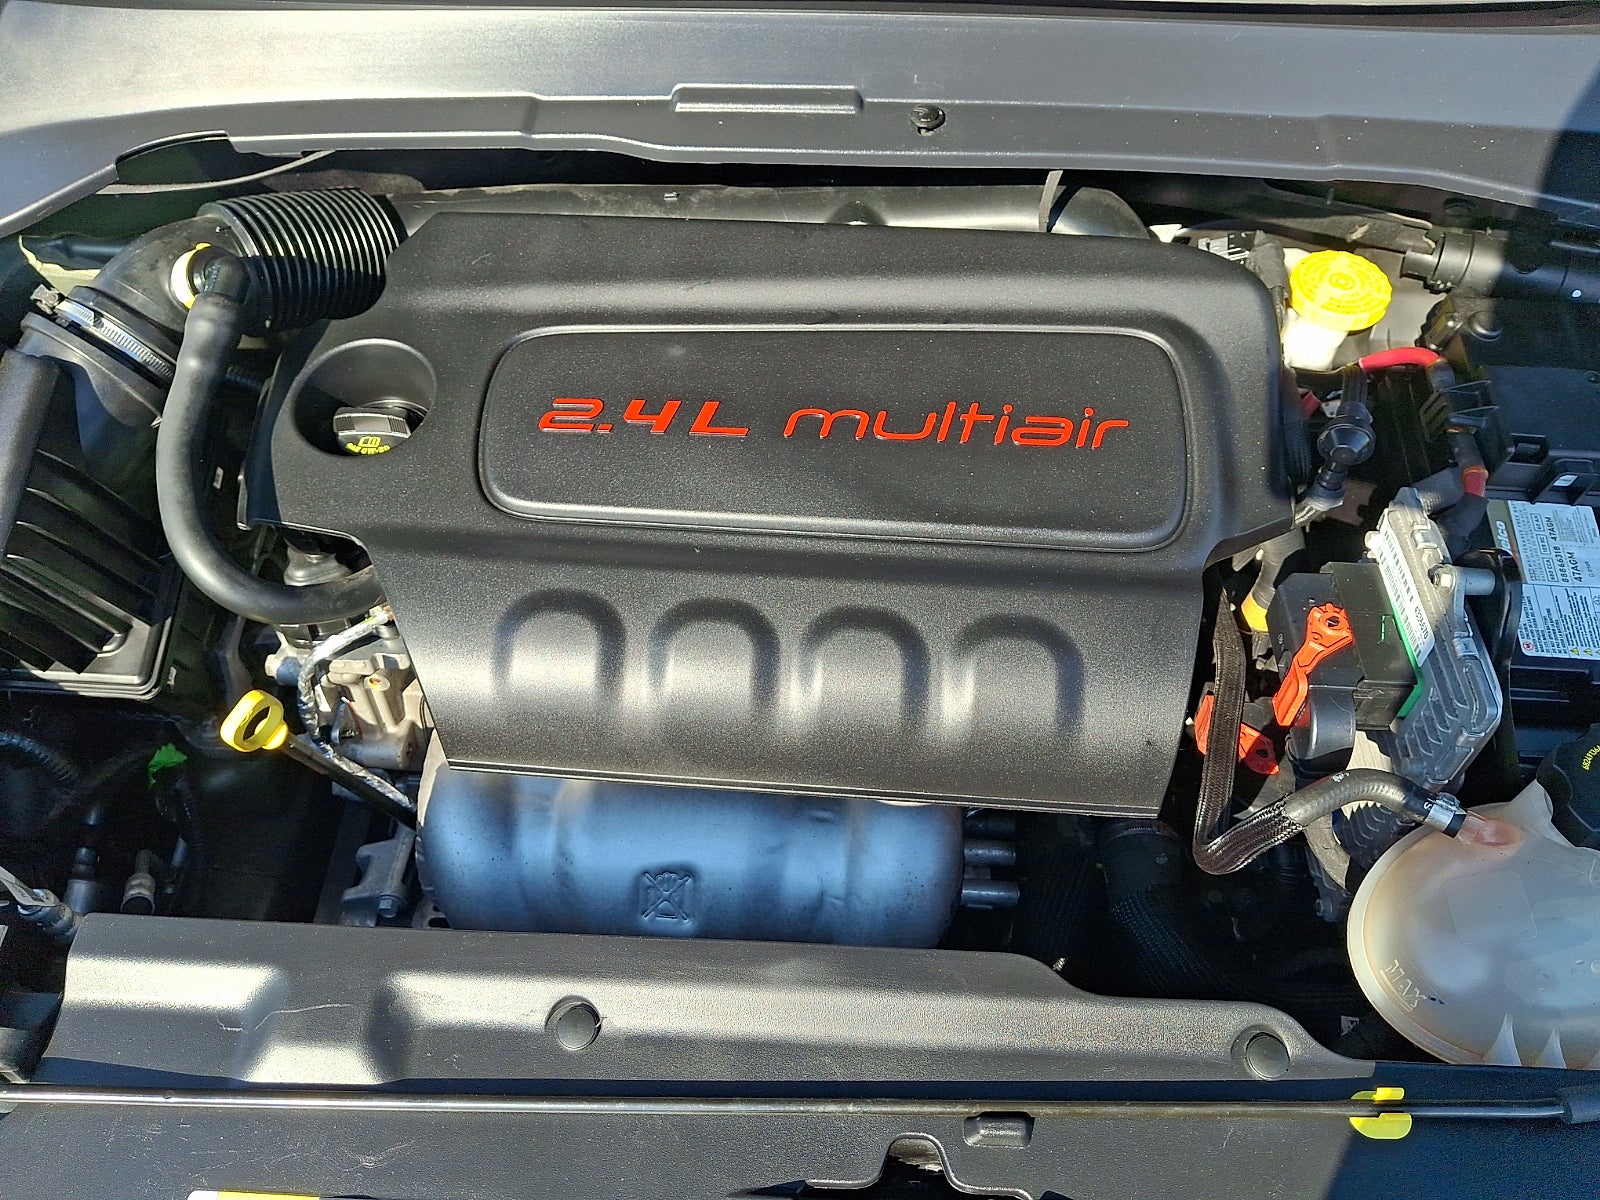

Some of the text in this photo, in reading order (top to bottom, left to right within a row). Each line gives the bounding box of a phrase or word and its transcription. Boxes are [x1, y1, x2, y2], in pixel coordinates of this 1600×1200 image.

[783, 400, 1130, 450] multiair
[1496, 520, 1513, 556] elco
[1545, 517, 1559, 542] 47AGM
[1553, 546, 1570, 583] 88866318
[1567, 552, 1584, 583] 47AGM
